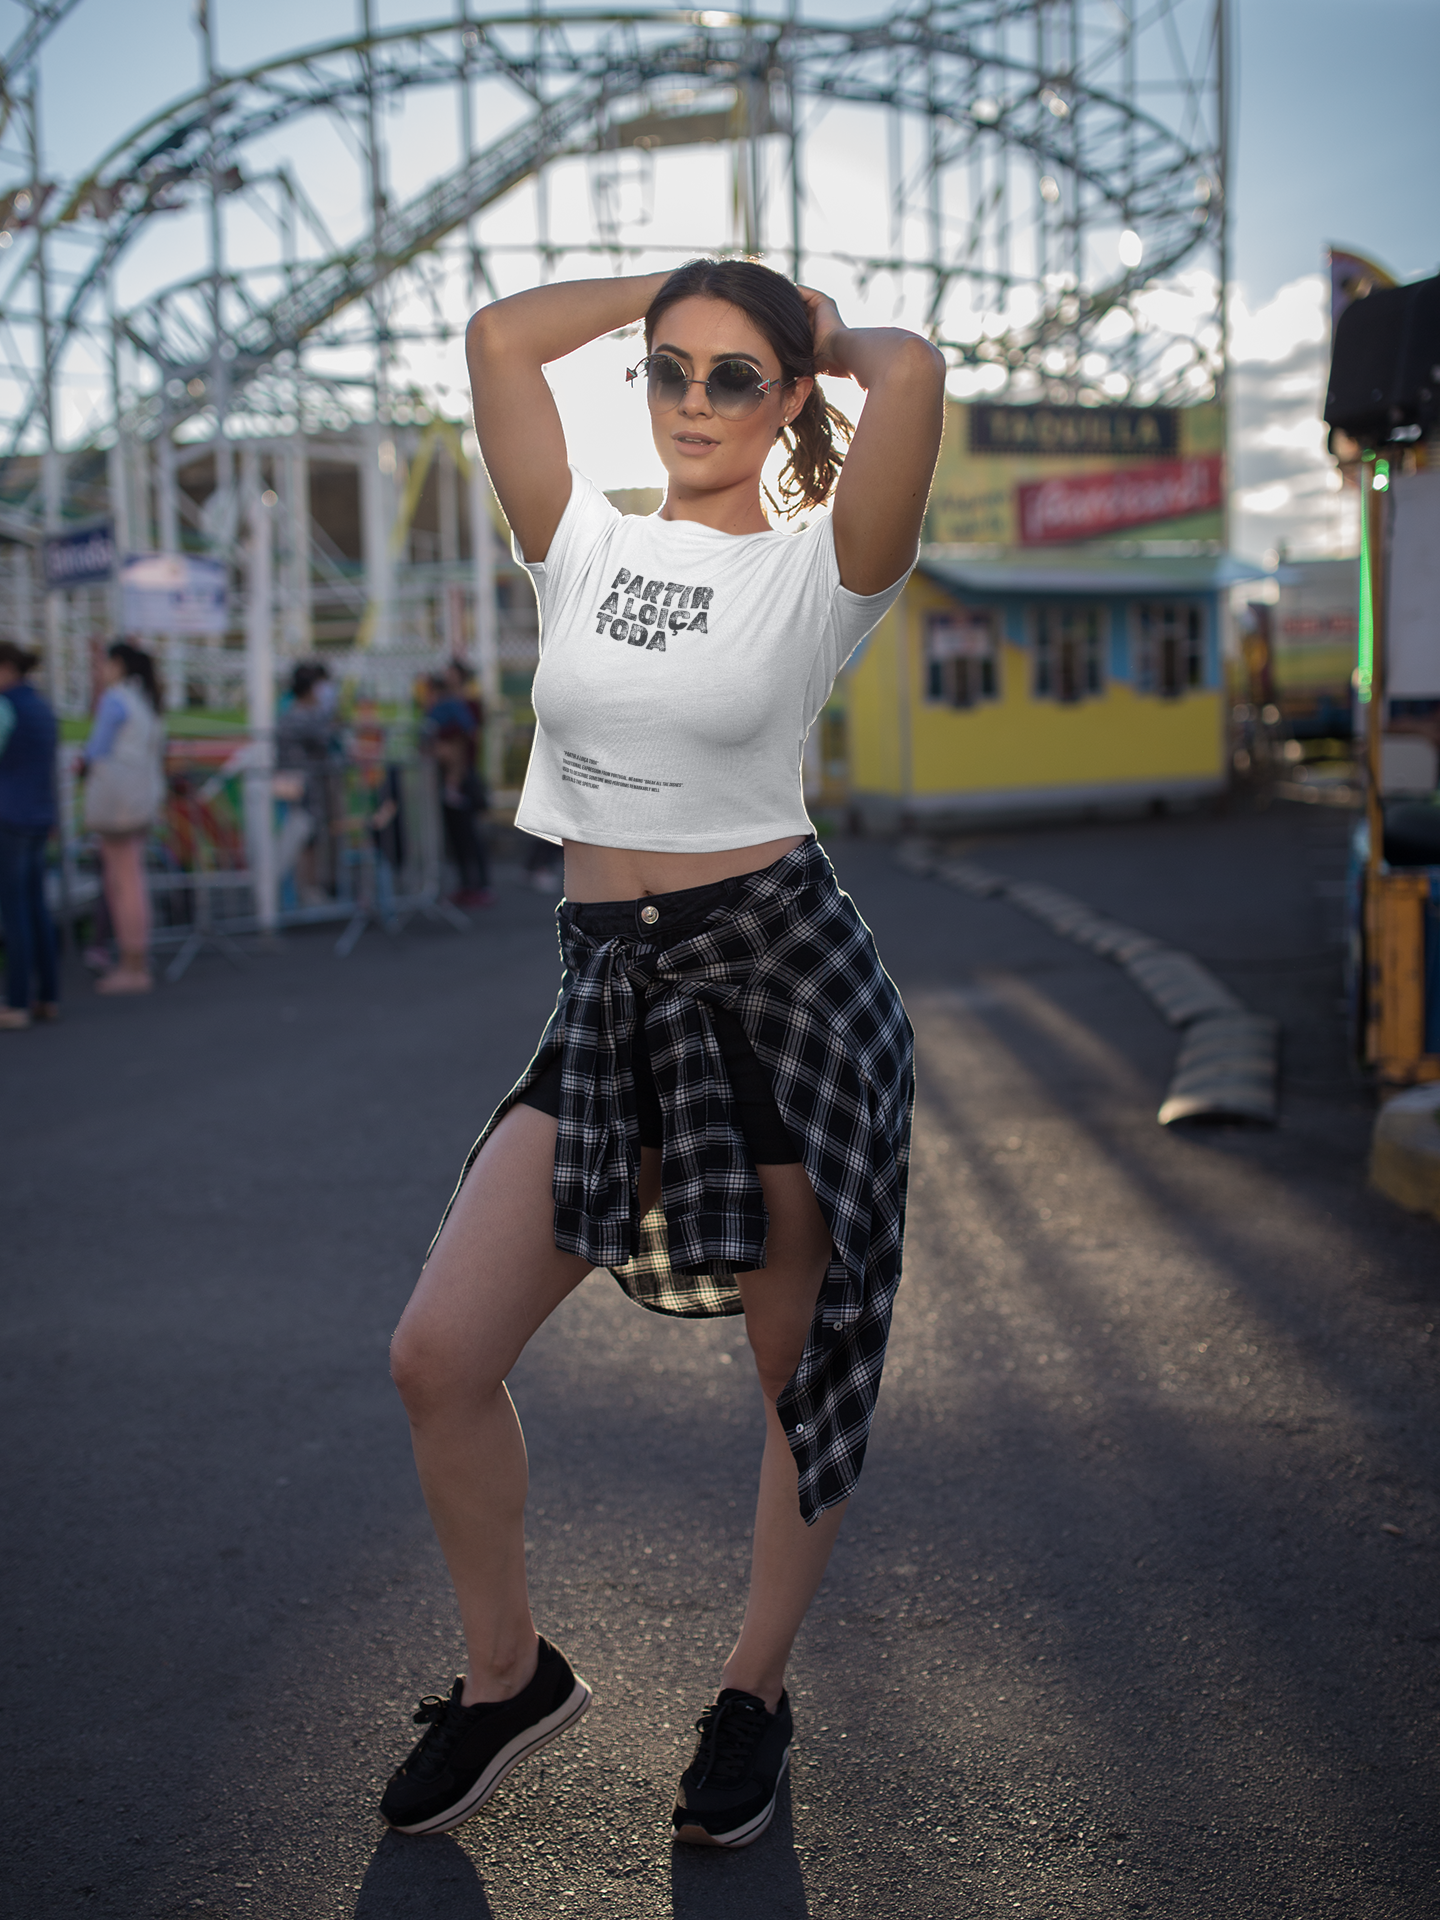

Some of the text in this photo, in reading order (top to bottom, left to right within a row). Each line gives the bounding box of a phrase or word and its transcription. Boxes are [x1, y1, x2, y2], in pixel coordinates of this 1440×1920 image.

[611, 567, 714, 610] PARTIR
[595, 611, 667, 652] TODA
[599, 591, 708, 636] A LOIÇA
